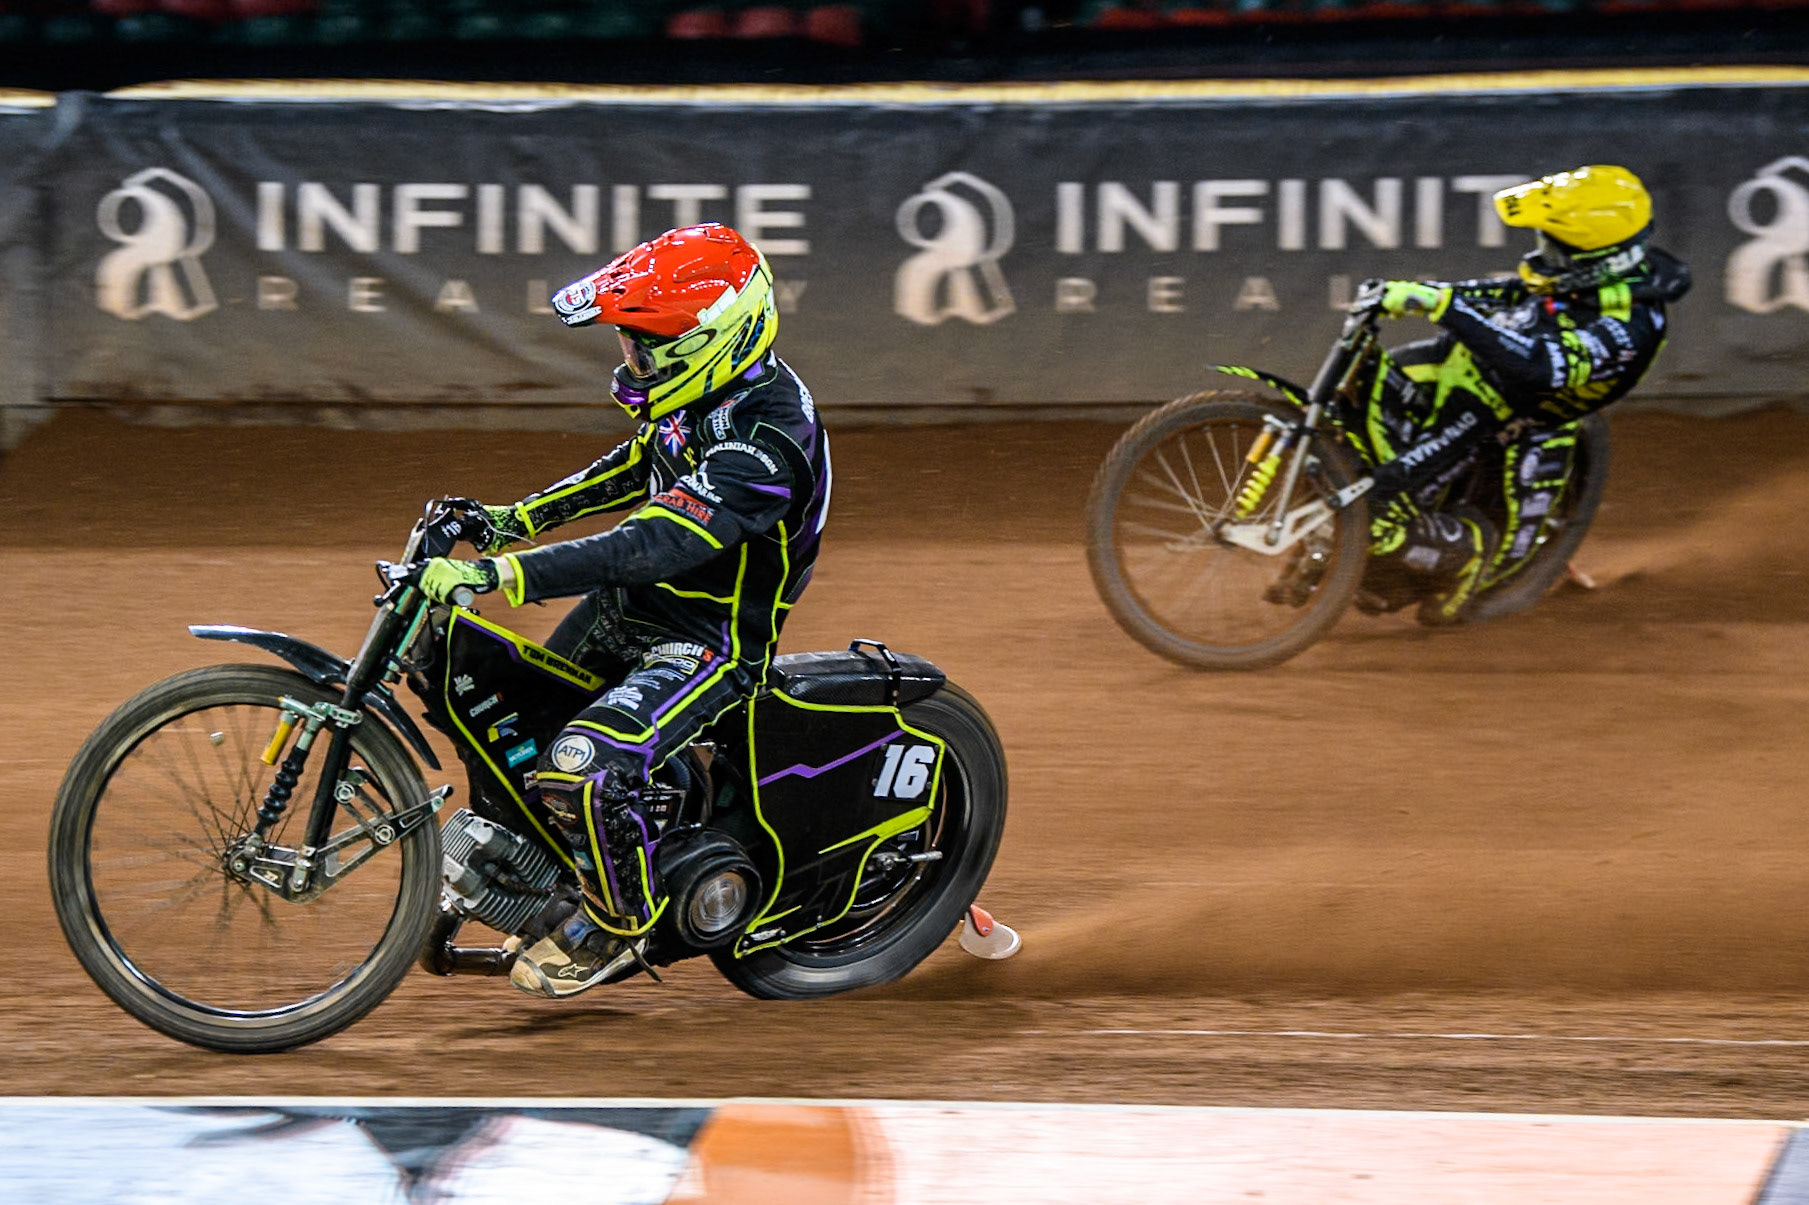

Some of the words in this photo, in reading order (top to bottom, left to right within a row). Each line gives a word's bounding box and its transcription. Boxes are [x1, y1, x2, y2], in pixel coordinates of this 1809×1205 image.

[257, 182, 811, 254] INFINITE
[1056, 175, 1532, 253] INFINIT
[685, 503, 713, 524] HIRE
[873, 744, 936, 799] 16
